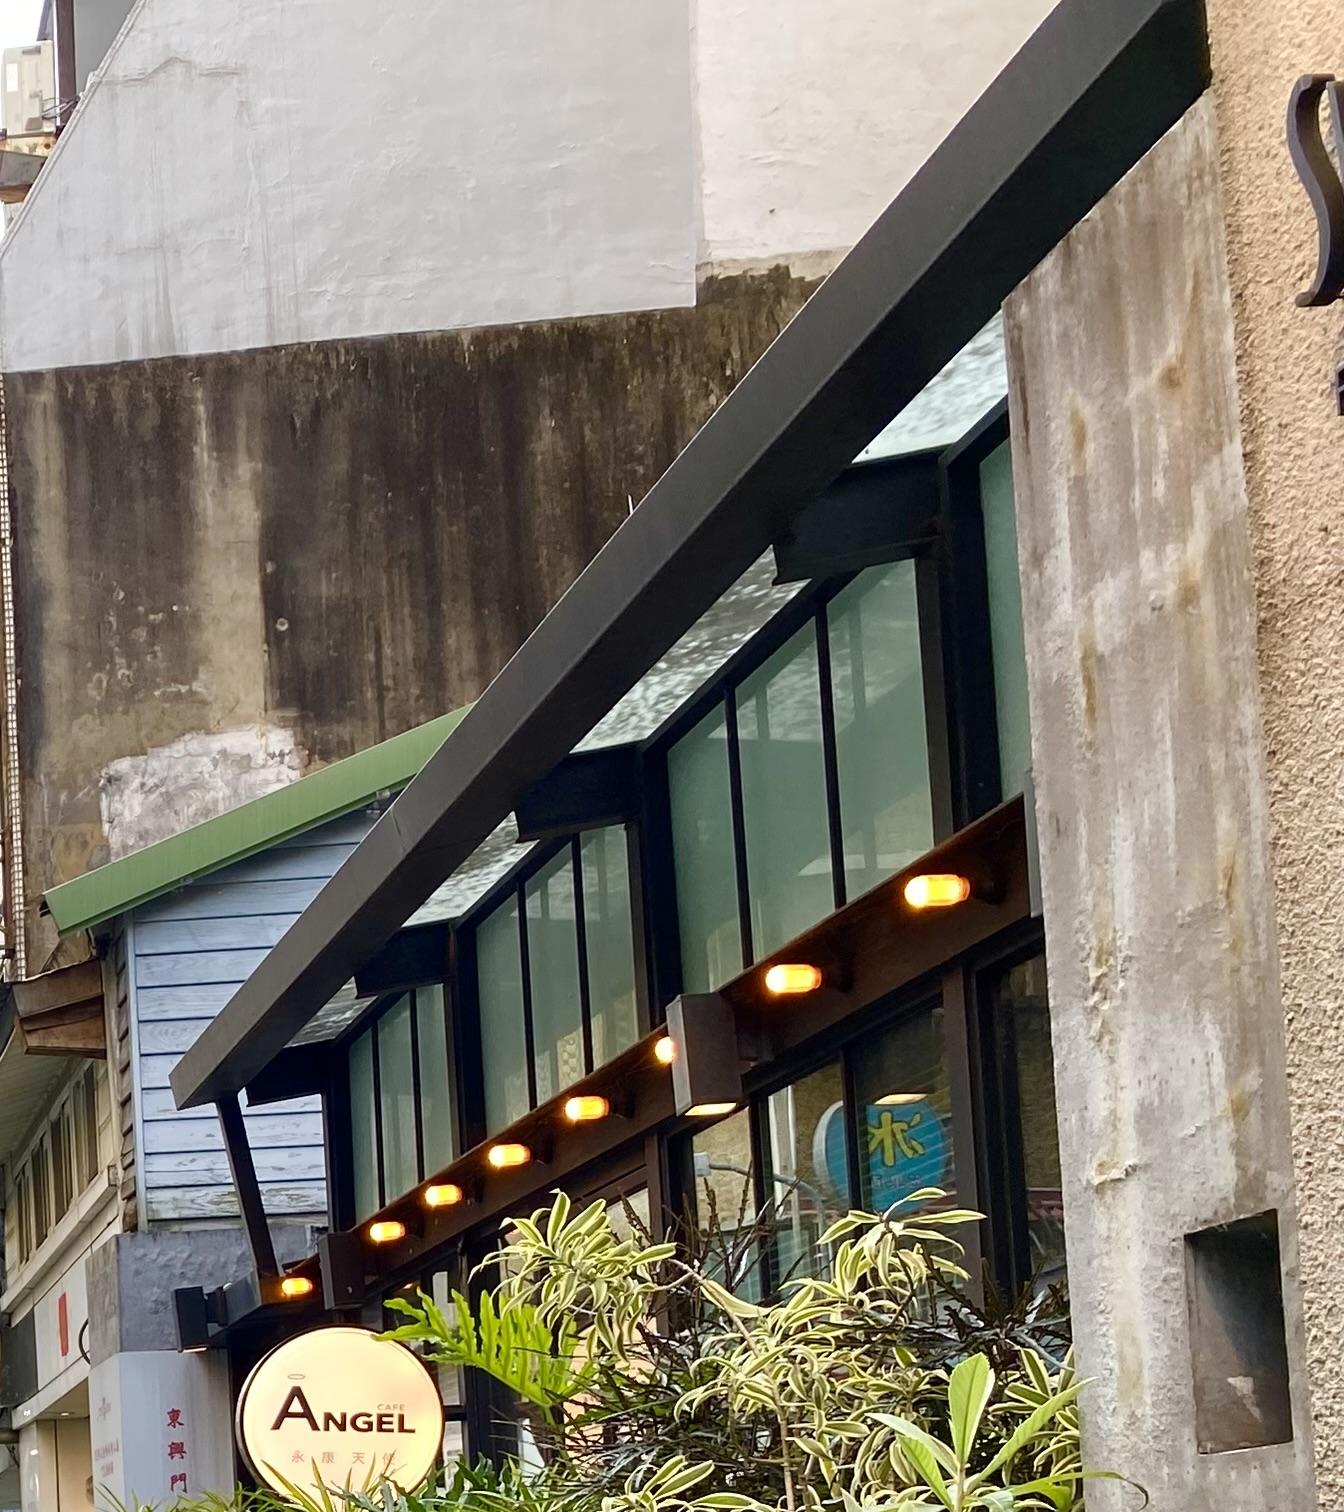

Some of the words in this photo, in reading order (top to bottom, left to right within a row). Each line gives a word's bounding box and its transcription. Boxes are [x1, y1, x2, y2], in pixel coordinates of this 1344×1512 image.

[377, 1403, 406, 1411] CAFE
[167, 1408, 188, 1494] 東興門
